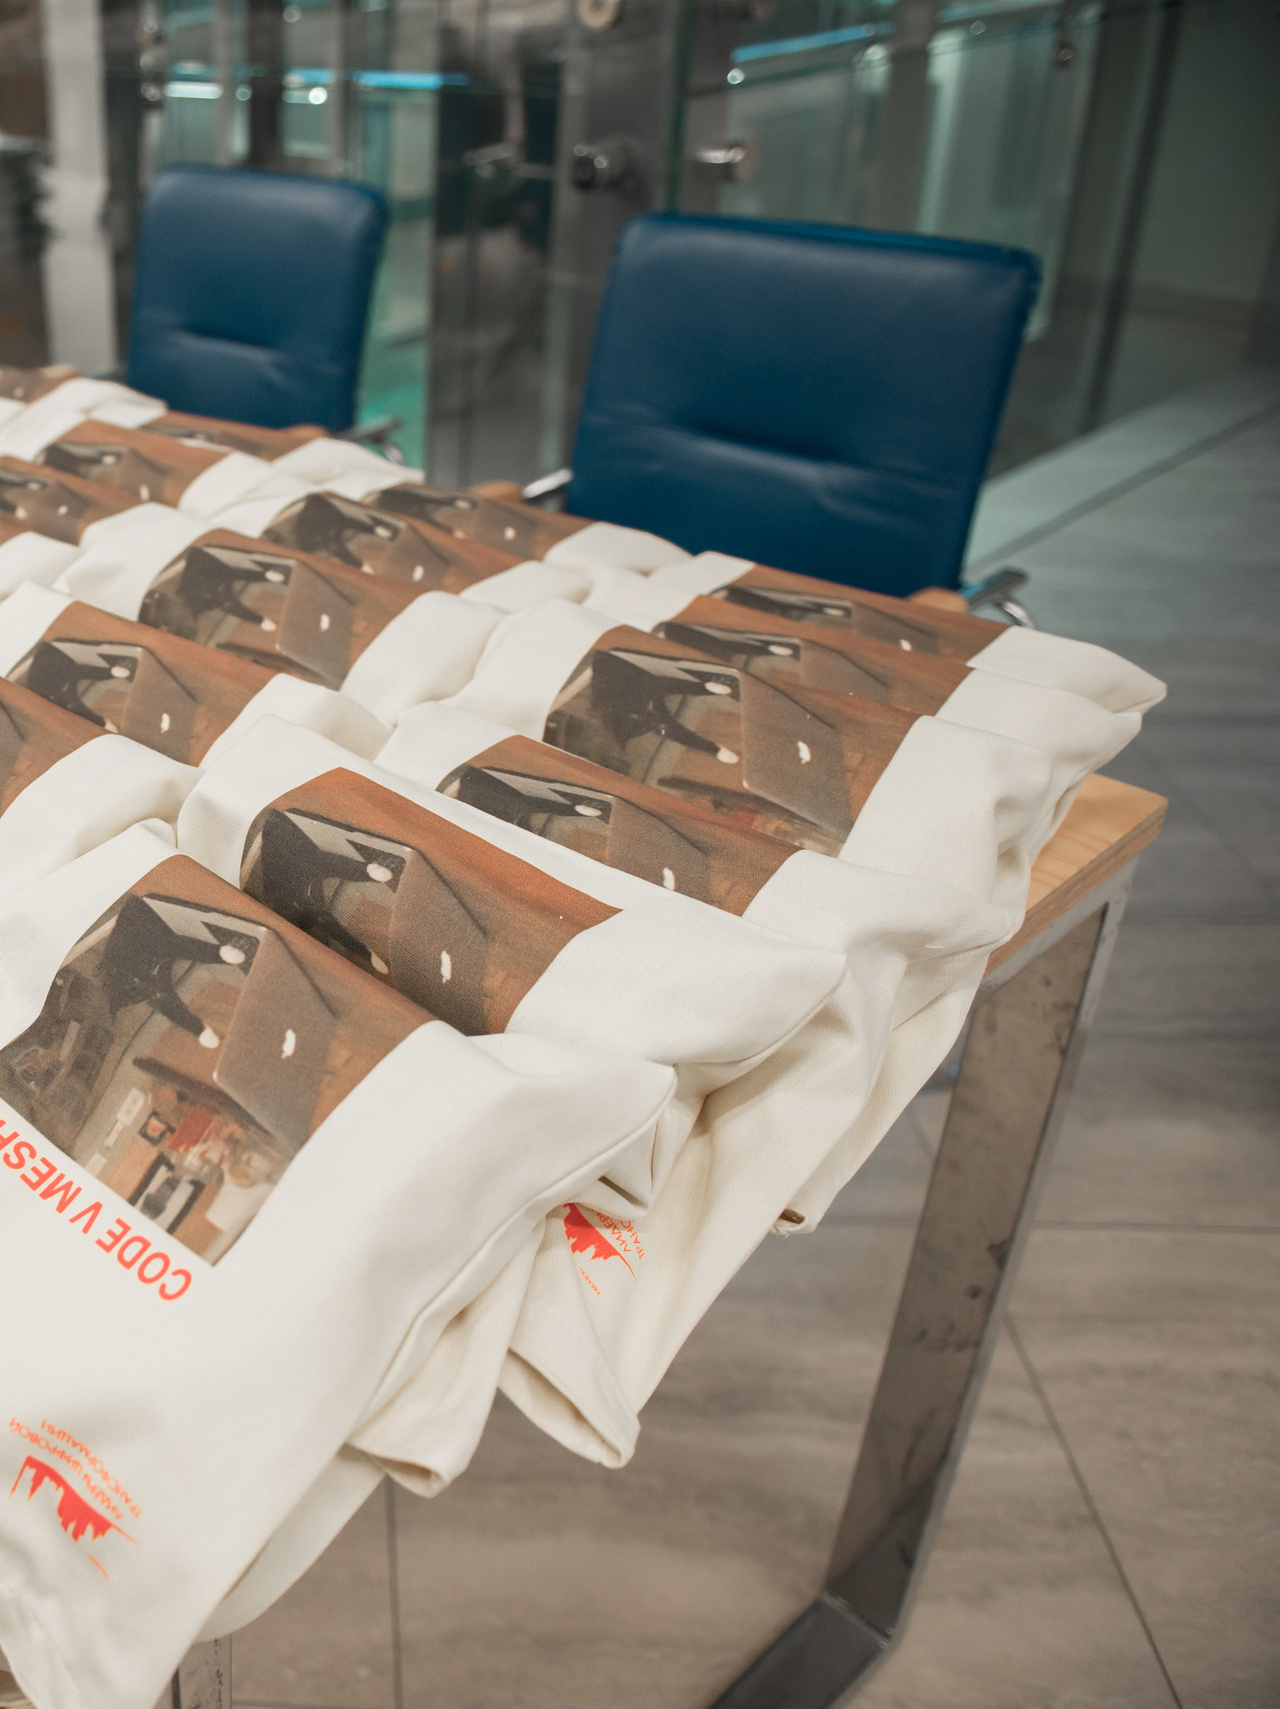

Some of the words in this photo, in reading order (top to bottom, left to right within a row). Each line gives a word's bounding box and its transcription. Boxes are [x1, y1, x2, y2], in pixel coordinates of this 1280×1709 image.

[68, 1200, 104, 1236] V
[94, 1217, 193, 1302] CODE
[9, 1416, 84, 1477] ЦИФРОВОЙ
